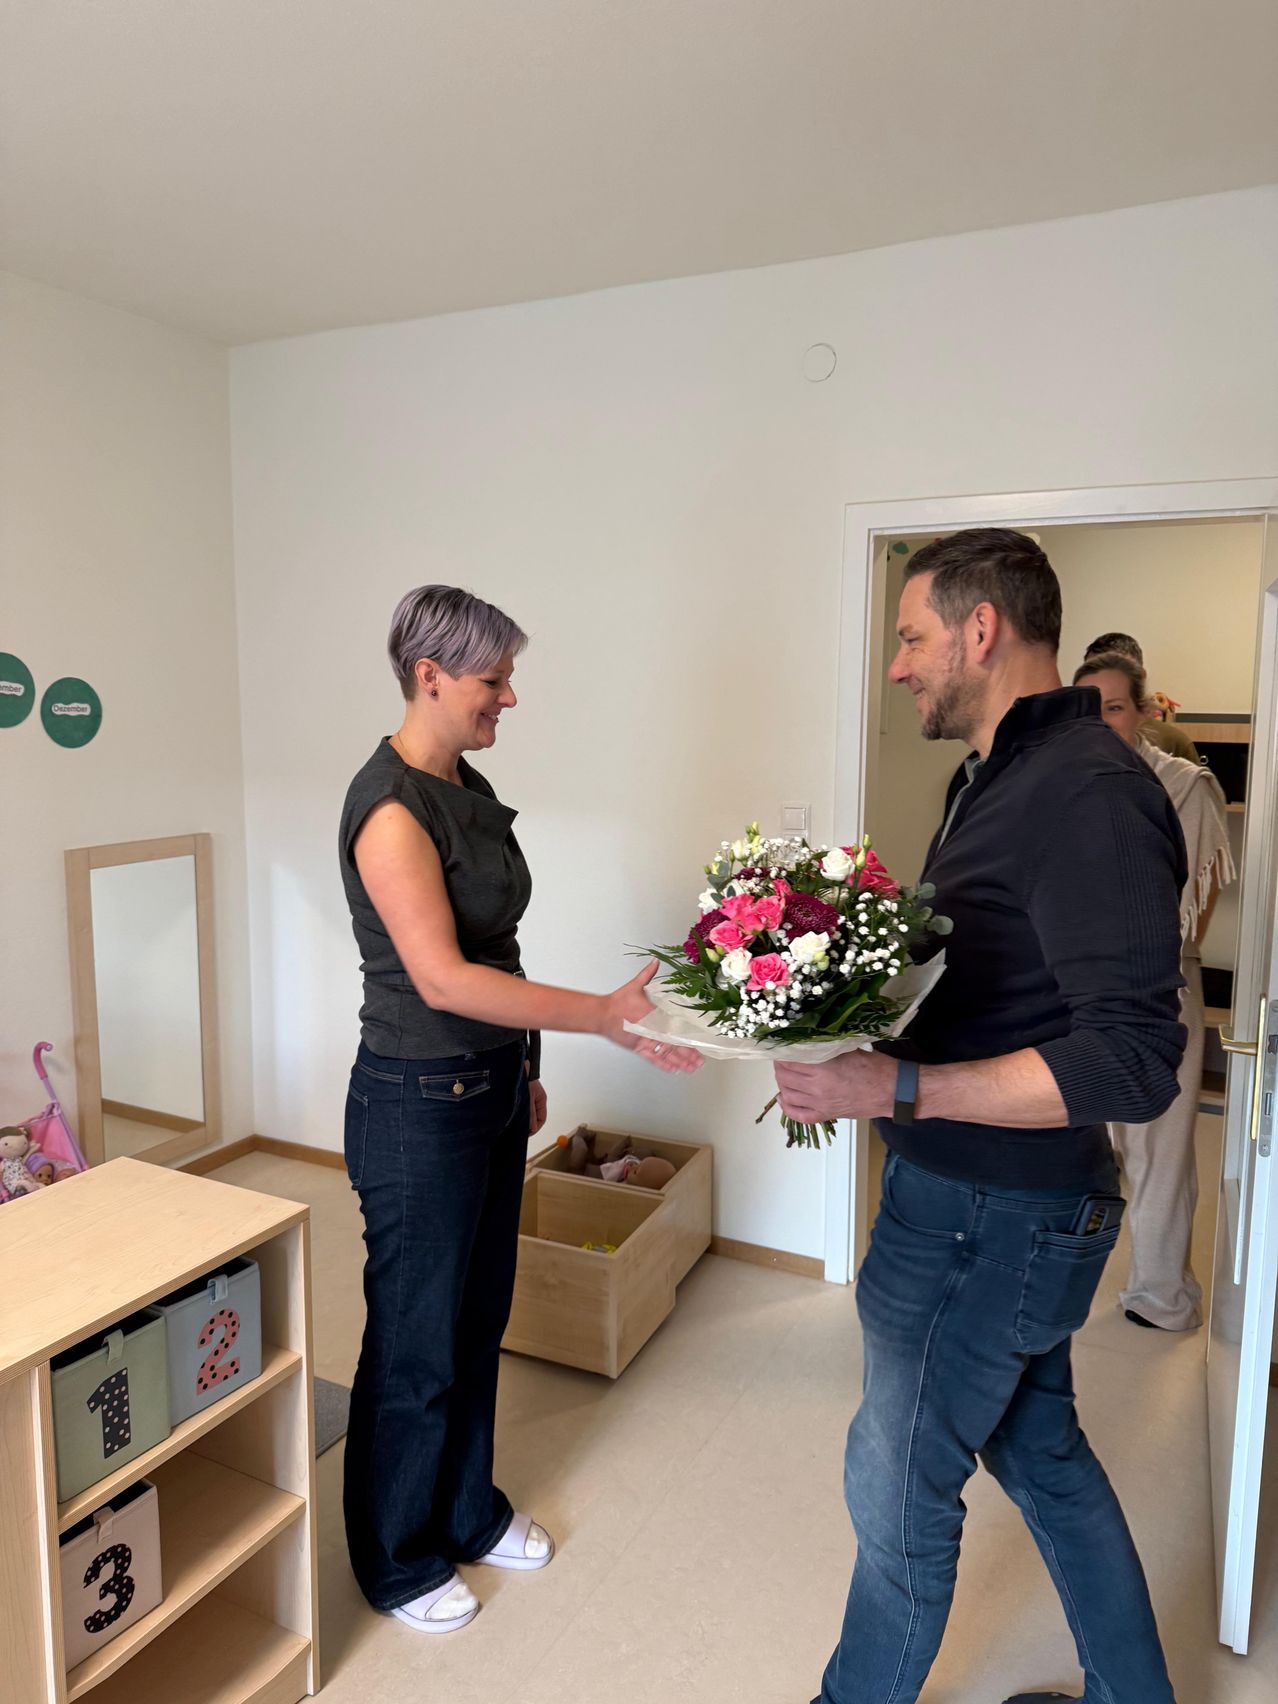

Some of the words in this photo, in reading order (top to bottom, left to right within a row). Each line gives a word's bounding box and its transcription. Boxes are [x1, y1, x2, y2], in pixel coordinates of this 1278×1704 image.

[0, 684, 22, 693] mber
[53, 704, 88, 713] Dezember
[196, 1309, 241, 1396] 2
[86, 1367, 131, 1459] 1
[83, 1543, 136, 1634] 3
